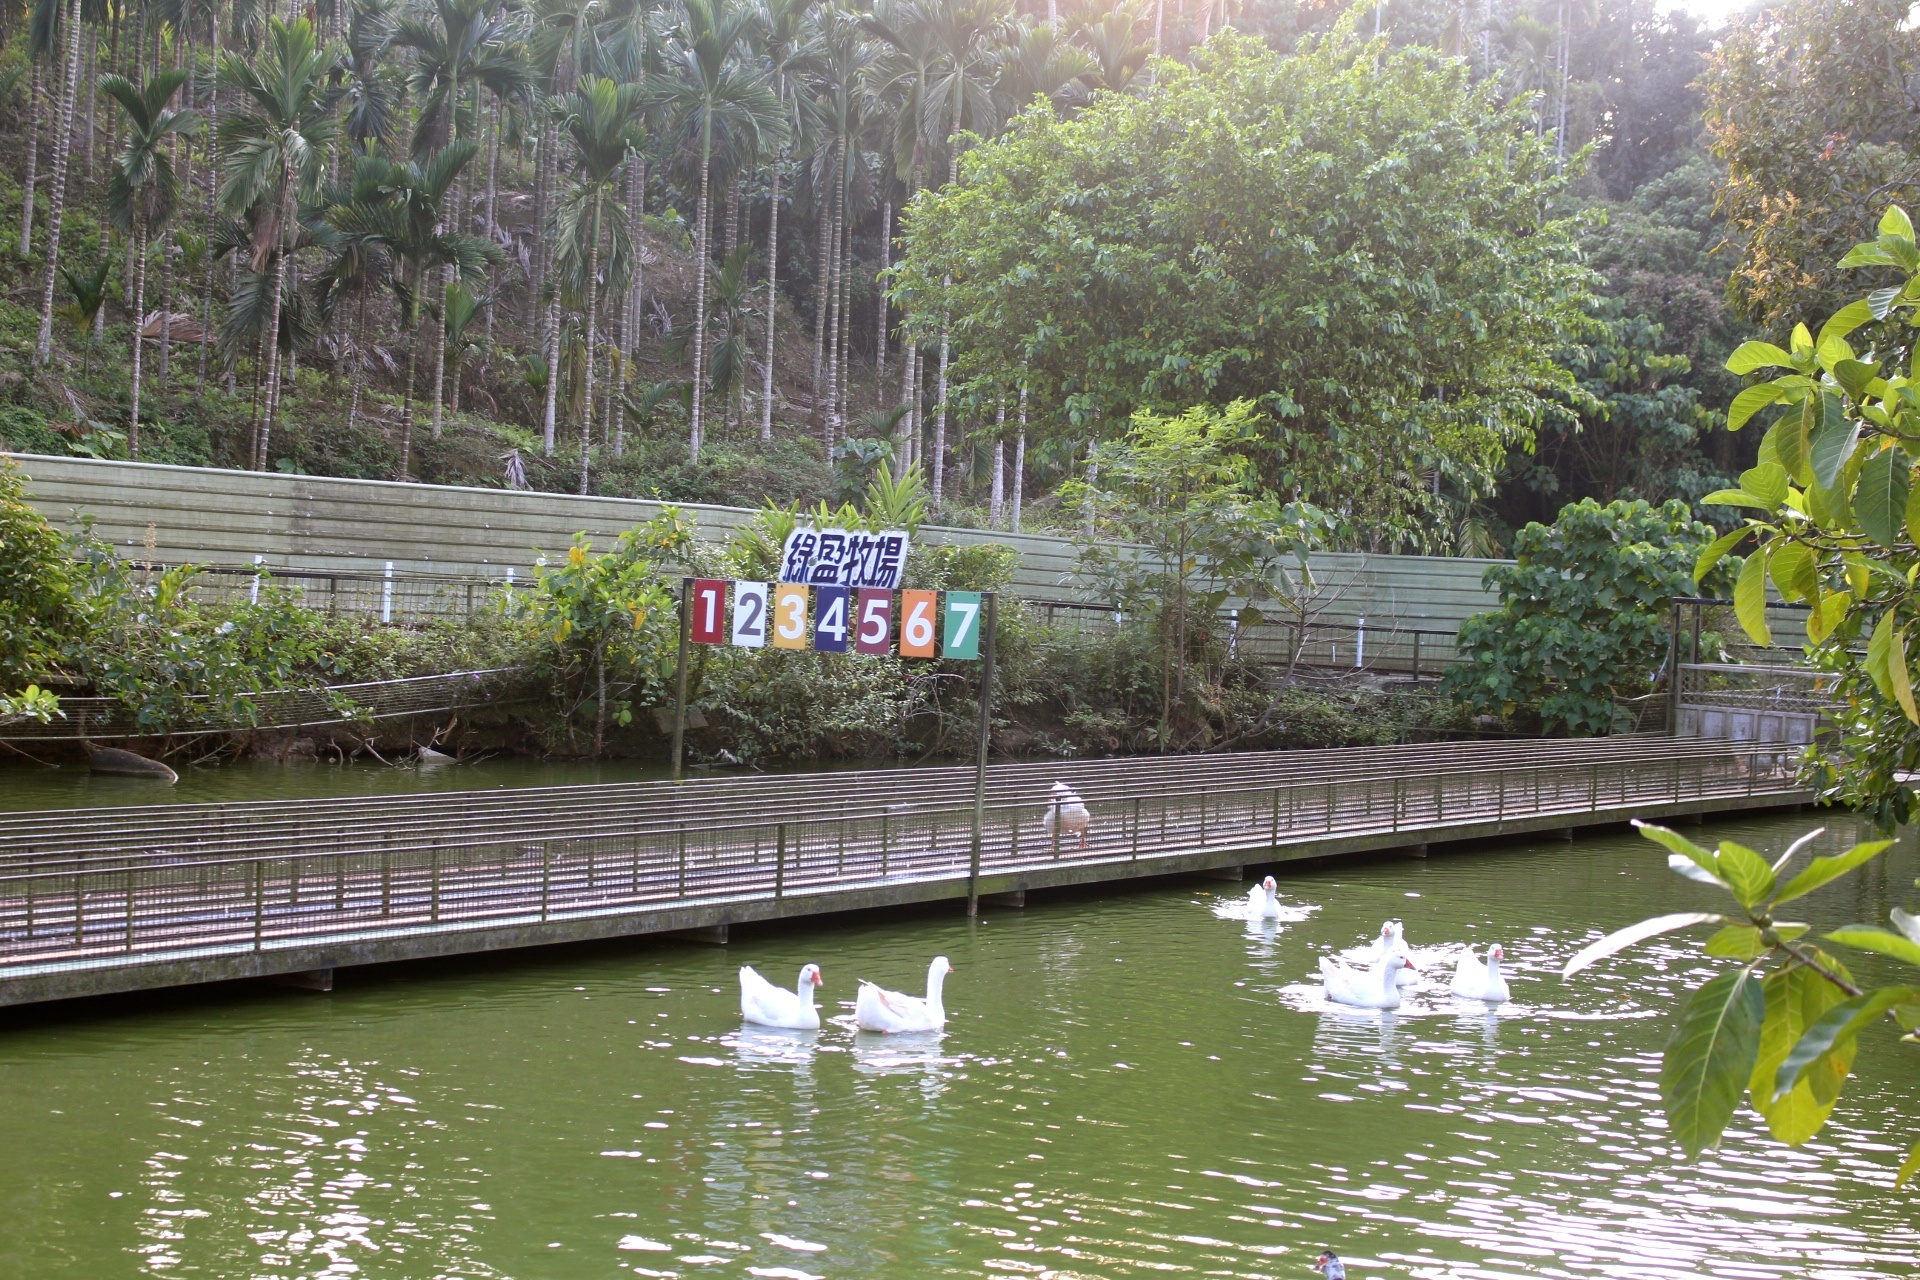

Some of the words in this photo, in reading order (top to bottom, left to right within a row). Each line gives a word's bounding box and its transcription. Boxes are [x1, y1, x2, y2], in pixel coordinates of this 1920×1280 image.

[782, 533, 904, 588] 綠盈牧場
[701, 590, 716, 633] 1
[737, 592, 763, 636] 2
[778, 594, 805, 640] 3
[818, 596, 846, 642] 4
[860, 599, 889, 644] 5
[905, 601, 932, 647] 6
[950, 603, 979, 648] 7
